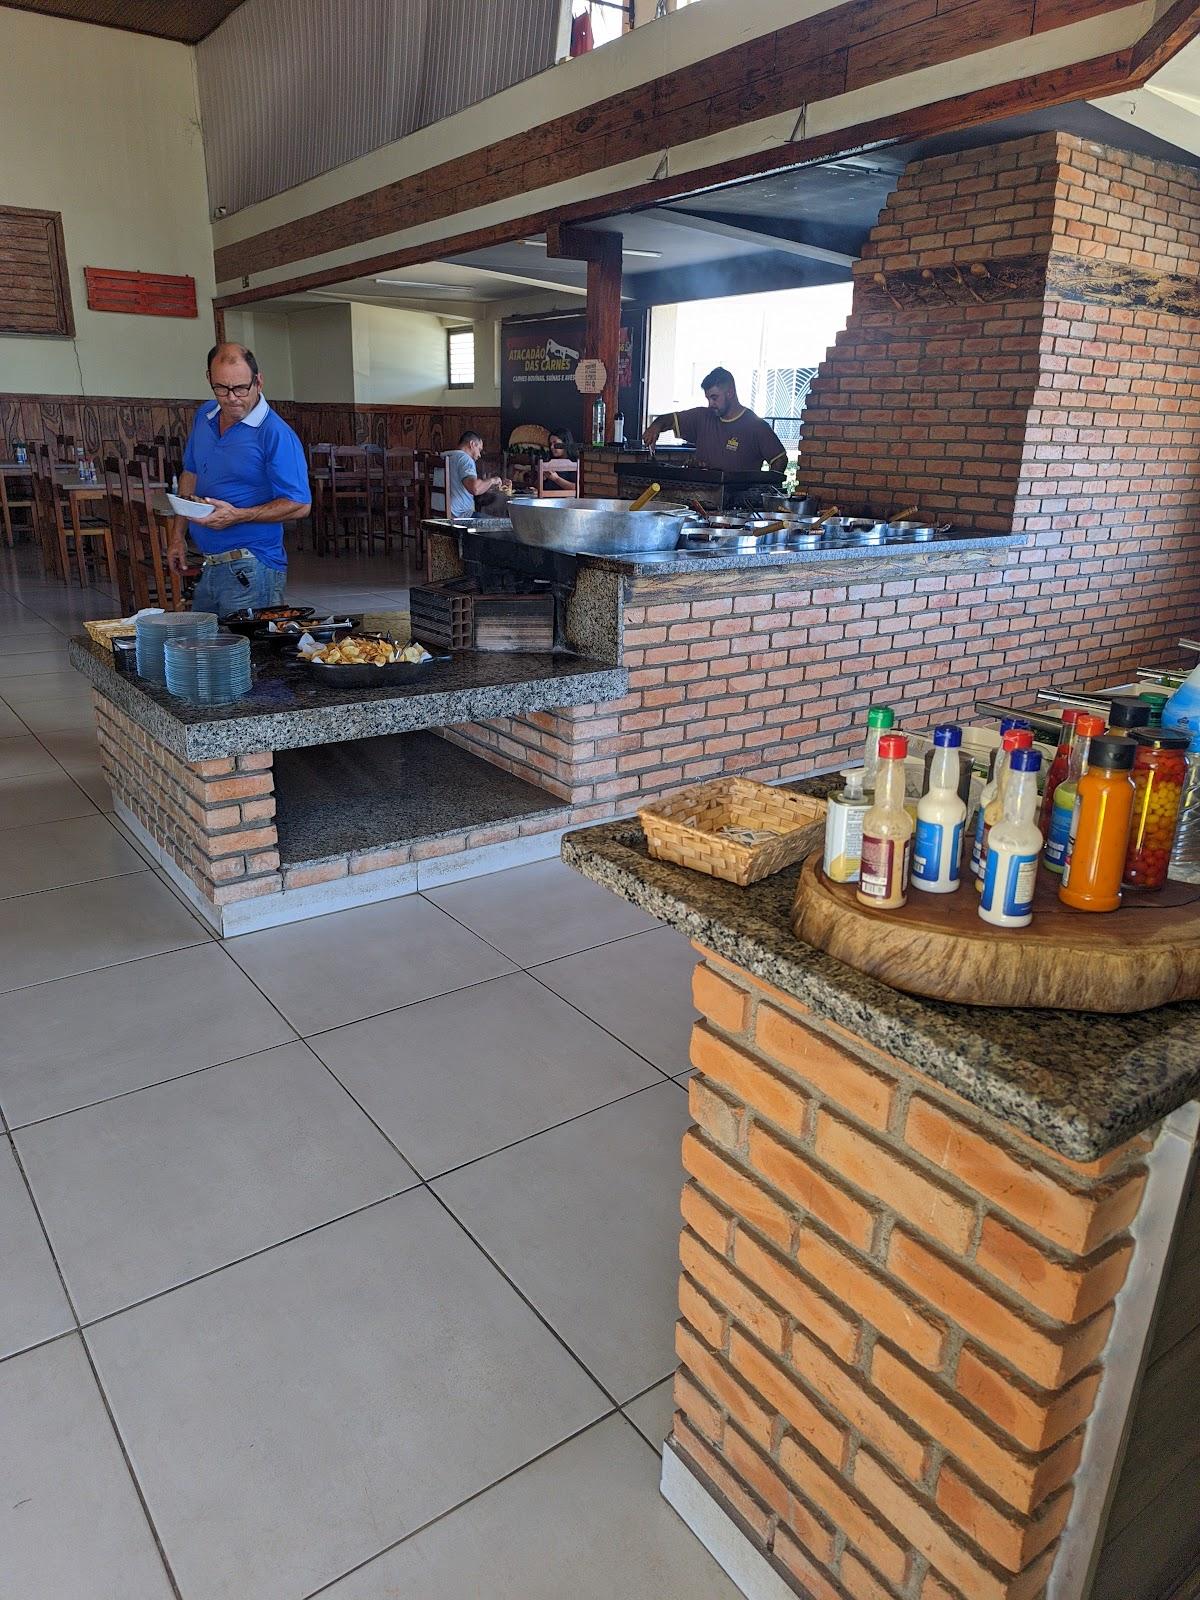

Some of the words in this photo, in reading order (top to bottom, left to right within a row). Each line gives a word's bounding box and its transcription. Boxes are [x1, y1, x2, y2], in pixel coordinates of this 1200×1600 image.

[508, 345, 546, 361] ATACADÃO
[525, 360, 540, 371] DAS
[541, 358, 571, 371] CARNES
